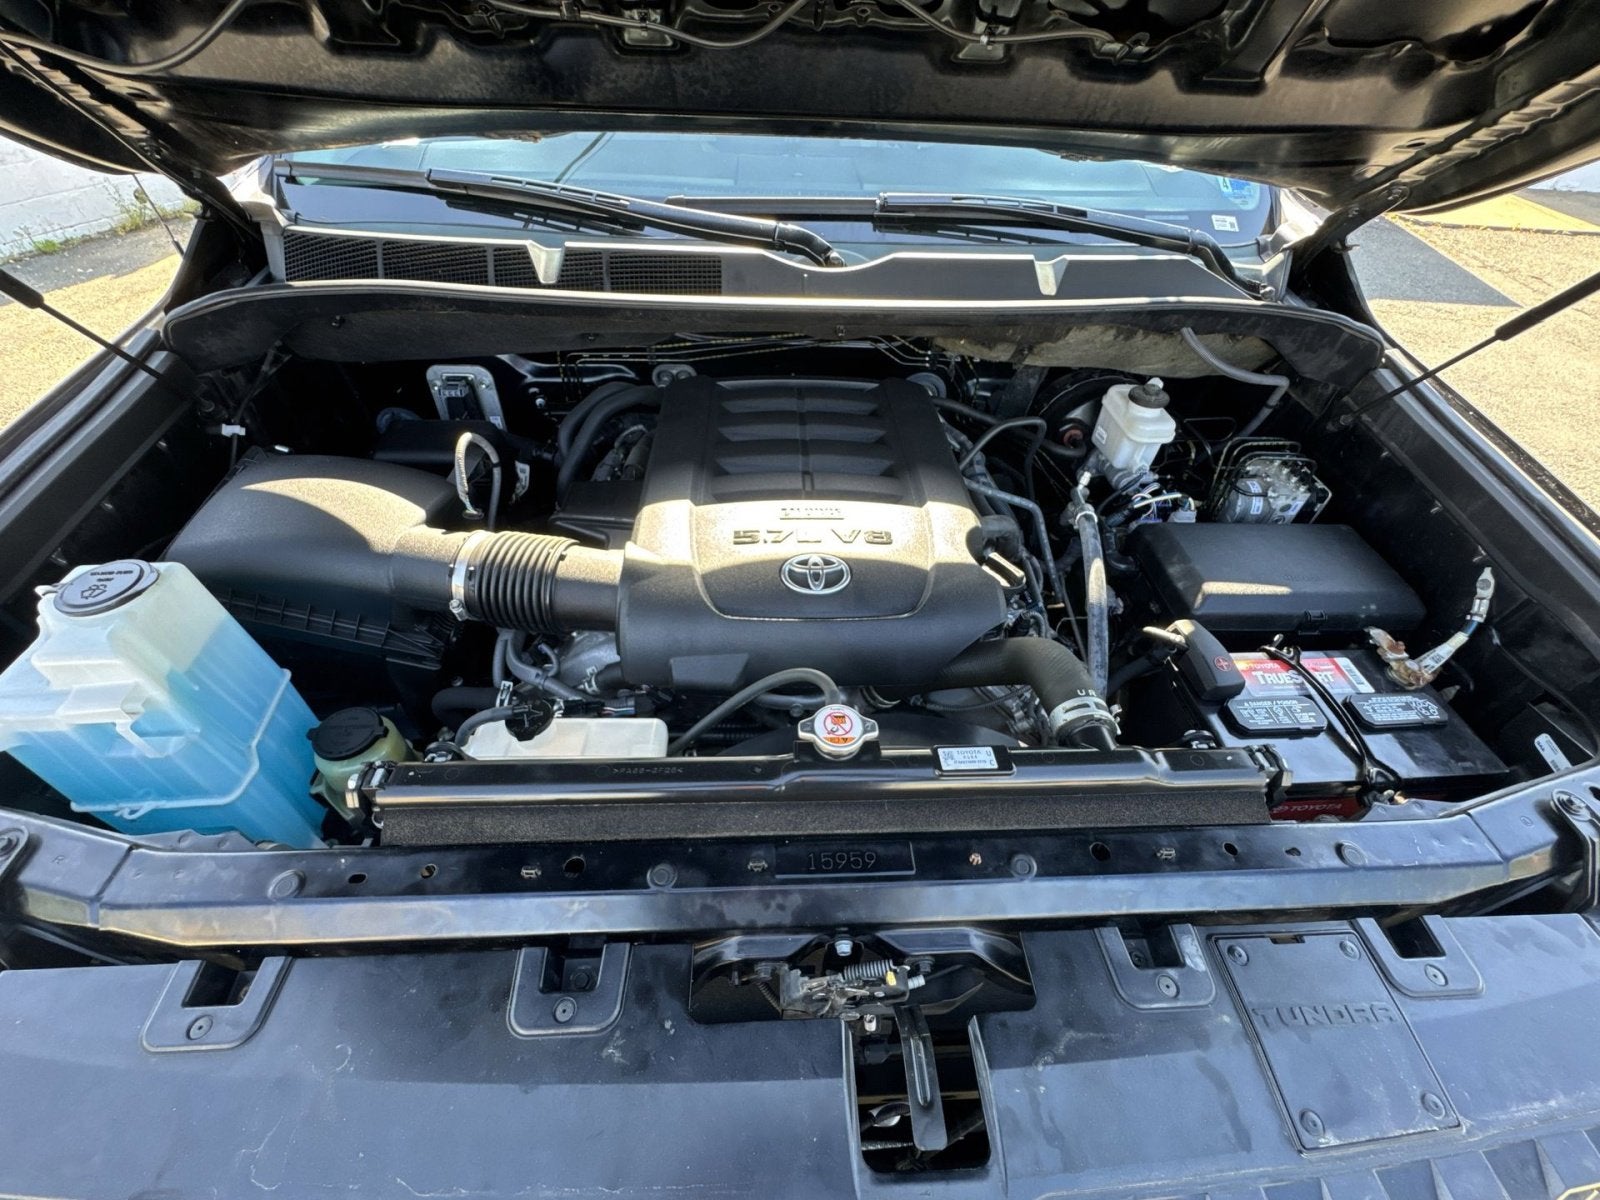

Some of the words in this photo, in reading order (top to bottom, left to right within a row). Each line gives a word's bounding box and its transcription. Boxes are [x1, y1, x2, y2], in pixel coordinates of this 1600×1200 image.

[830, 528, 894, 546] V8
[1250, 662, 1281, 670] TOYOTA
[1252, 670, 1335, 685] TRUESRT
[1291, 803, 1343, 812] TOYOTA
[808, 851, 877, 871] 15959
[1252, 1003, 1398, 1028] TUNDRA
